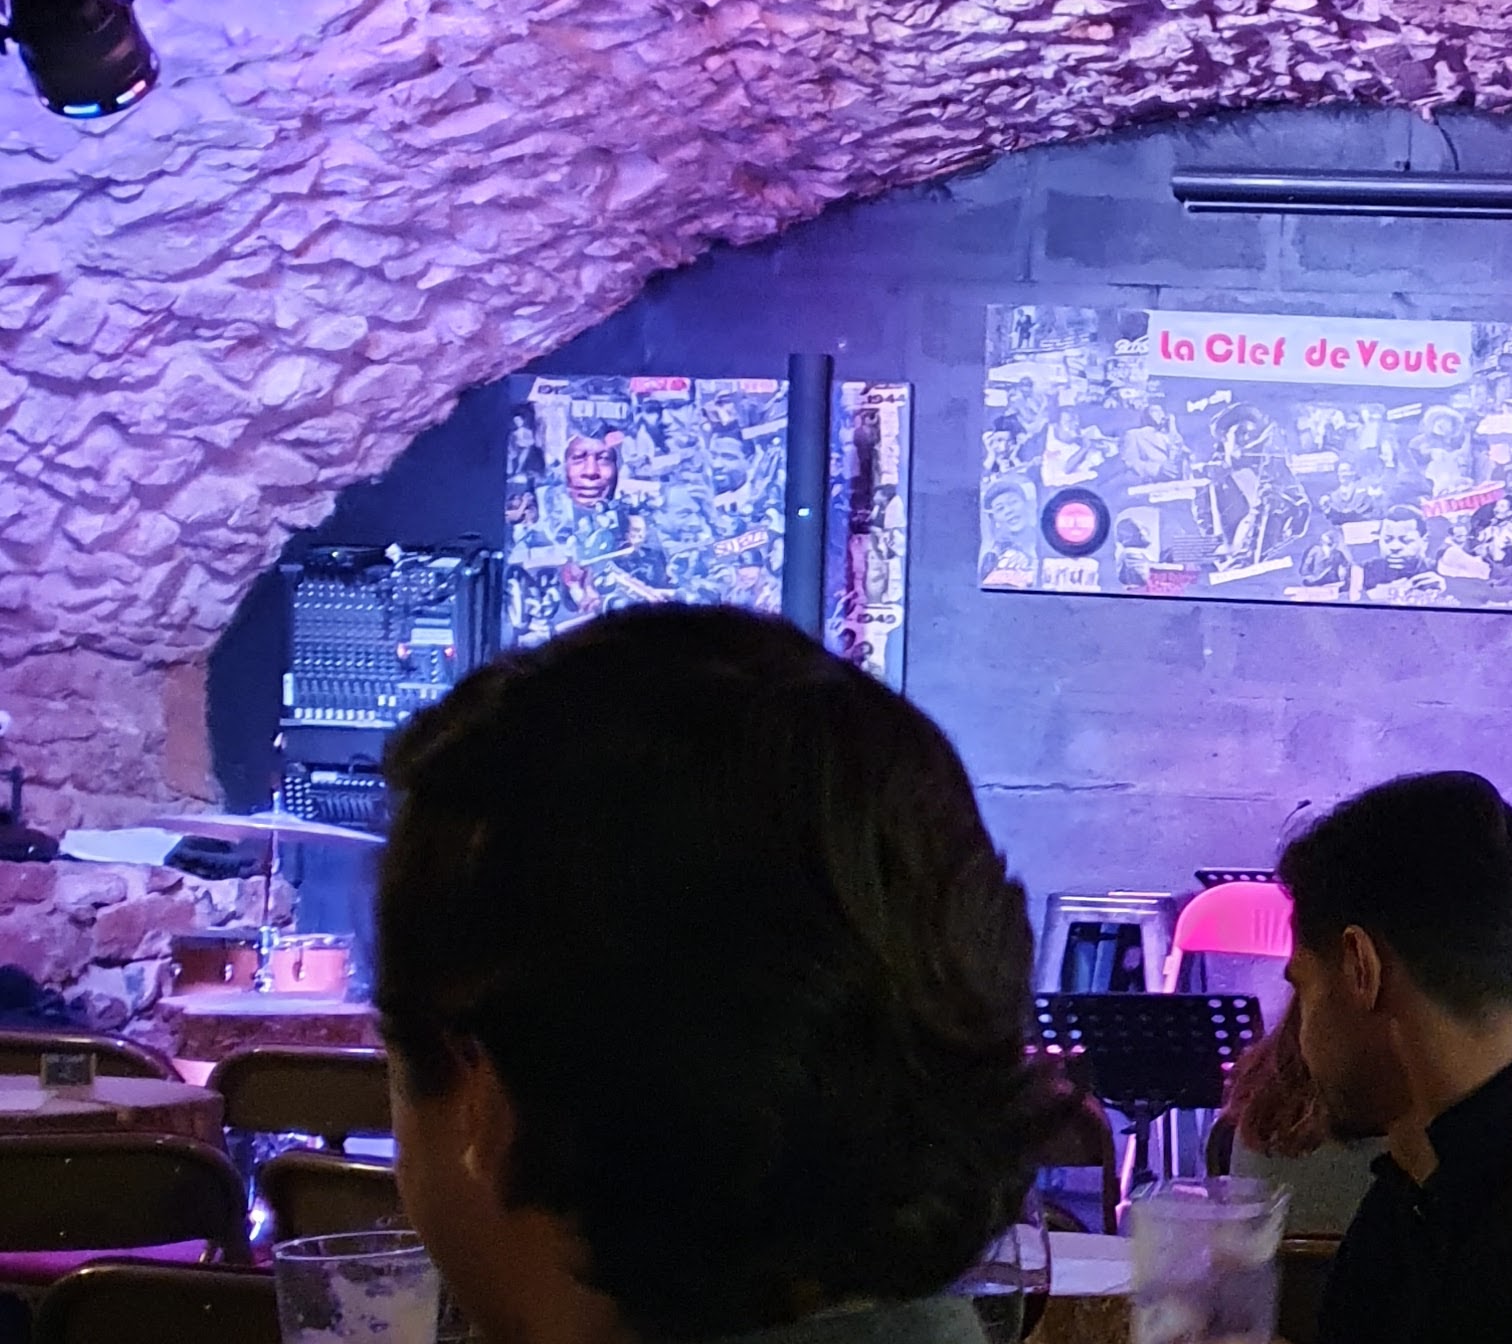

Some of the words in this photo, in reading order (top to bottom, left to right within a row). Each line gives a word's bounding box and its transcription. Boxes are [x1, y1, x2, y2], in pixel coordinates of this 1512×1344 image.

[1160, 329, 1195, 361] La
[1205, 332, 1286, 366] Clef
[1304, 337, 1350, 369] de
[1356, 339, 1462, 374] Voute
